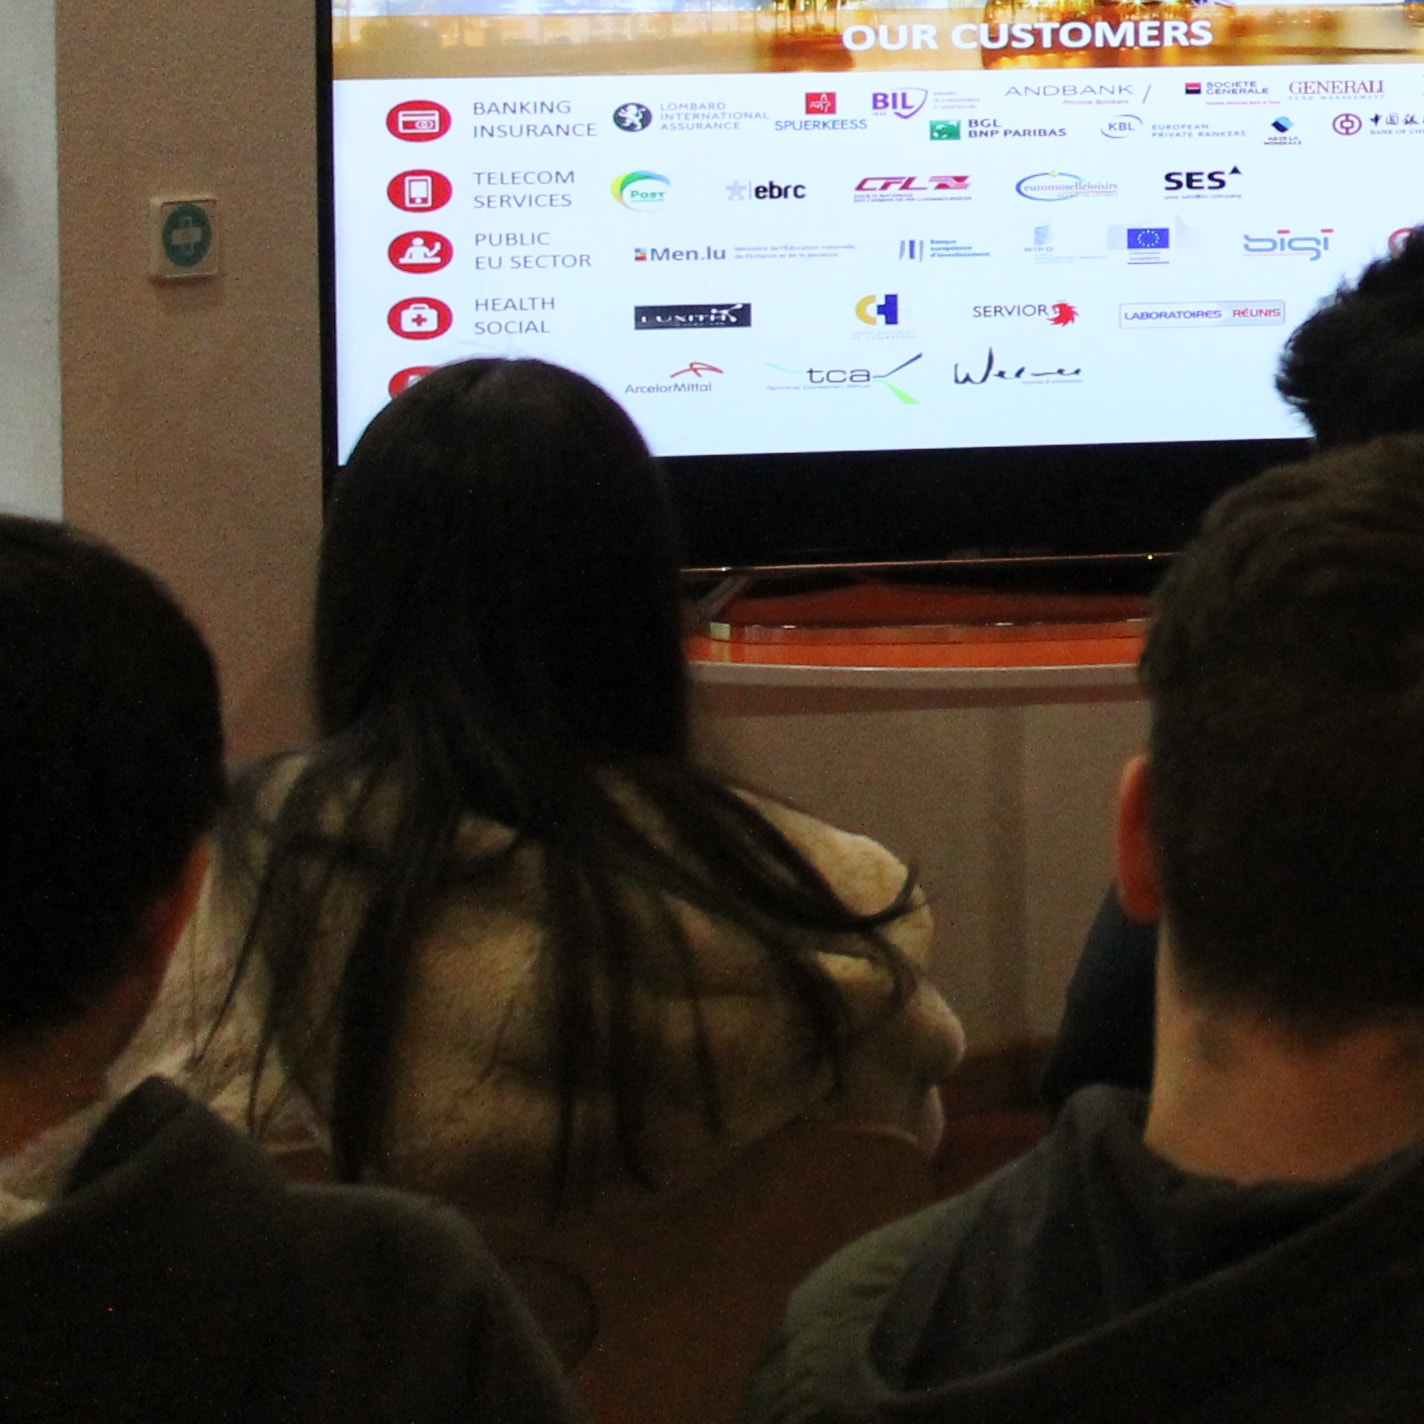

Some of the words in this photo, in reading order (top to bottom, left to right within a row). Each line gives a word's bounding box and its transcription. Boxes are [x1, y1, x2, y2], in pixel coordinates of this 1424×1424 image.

[843, 24, 939, 53] OUR
[951, 19, 1214, 51] CUSTOMERS
[1004, 84, 1133, 97] ANDBANK
[1288, 80, 1385, 95] GENERALI
[473, 100, 571, 116] BANKING
[660, 102, 726, 111] LOMBARD
[872, 92, 914, 110] BIL
[660, 111, 769, 121] INTERNATIONAL
[968, 119, 1001, 128] BGL
[473, 123, 597, 139] INSURANCE
[660, 122, 740, 131] ASSURANCE
[774, 119, 868, 132] SPUERKEESS
[1108, 122, 1135, 132] KBL
[968, 130, 999, 139] BNP
[1003, 128, 1067, 137] PARIBAS
[473, 170, 575, 186] TELECOM
[1164, 171, 1226, 191] SES
[754, 181, 807, 200] ebrc
[473, 193, 572, 209] SERVICES
[475, 231, 550, 247] PUBLIC
[651, 246, 726, 261] Men.lu
[475, 256, 502, 270] EU
[510, 253, 592, 269] SECTOR
[475, 297, 556, 312] HEALTH
[972, 305, 1049, 318] SERVIOR
[1124, 310, 1222, 320] LABORATOIRES
[1232, 308, 1281, 318] RÉUNIS
[475, 320, 550, 335] SOCIAL
[806, 368, 871, 384] tca
[625, 382, 712, 393] ArcelorMittal
